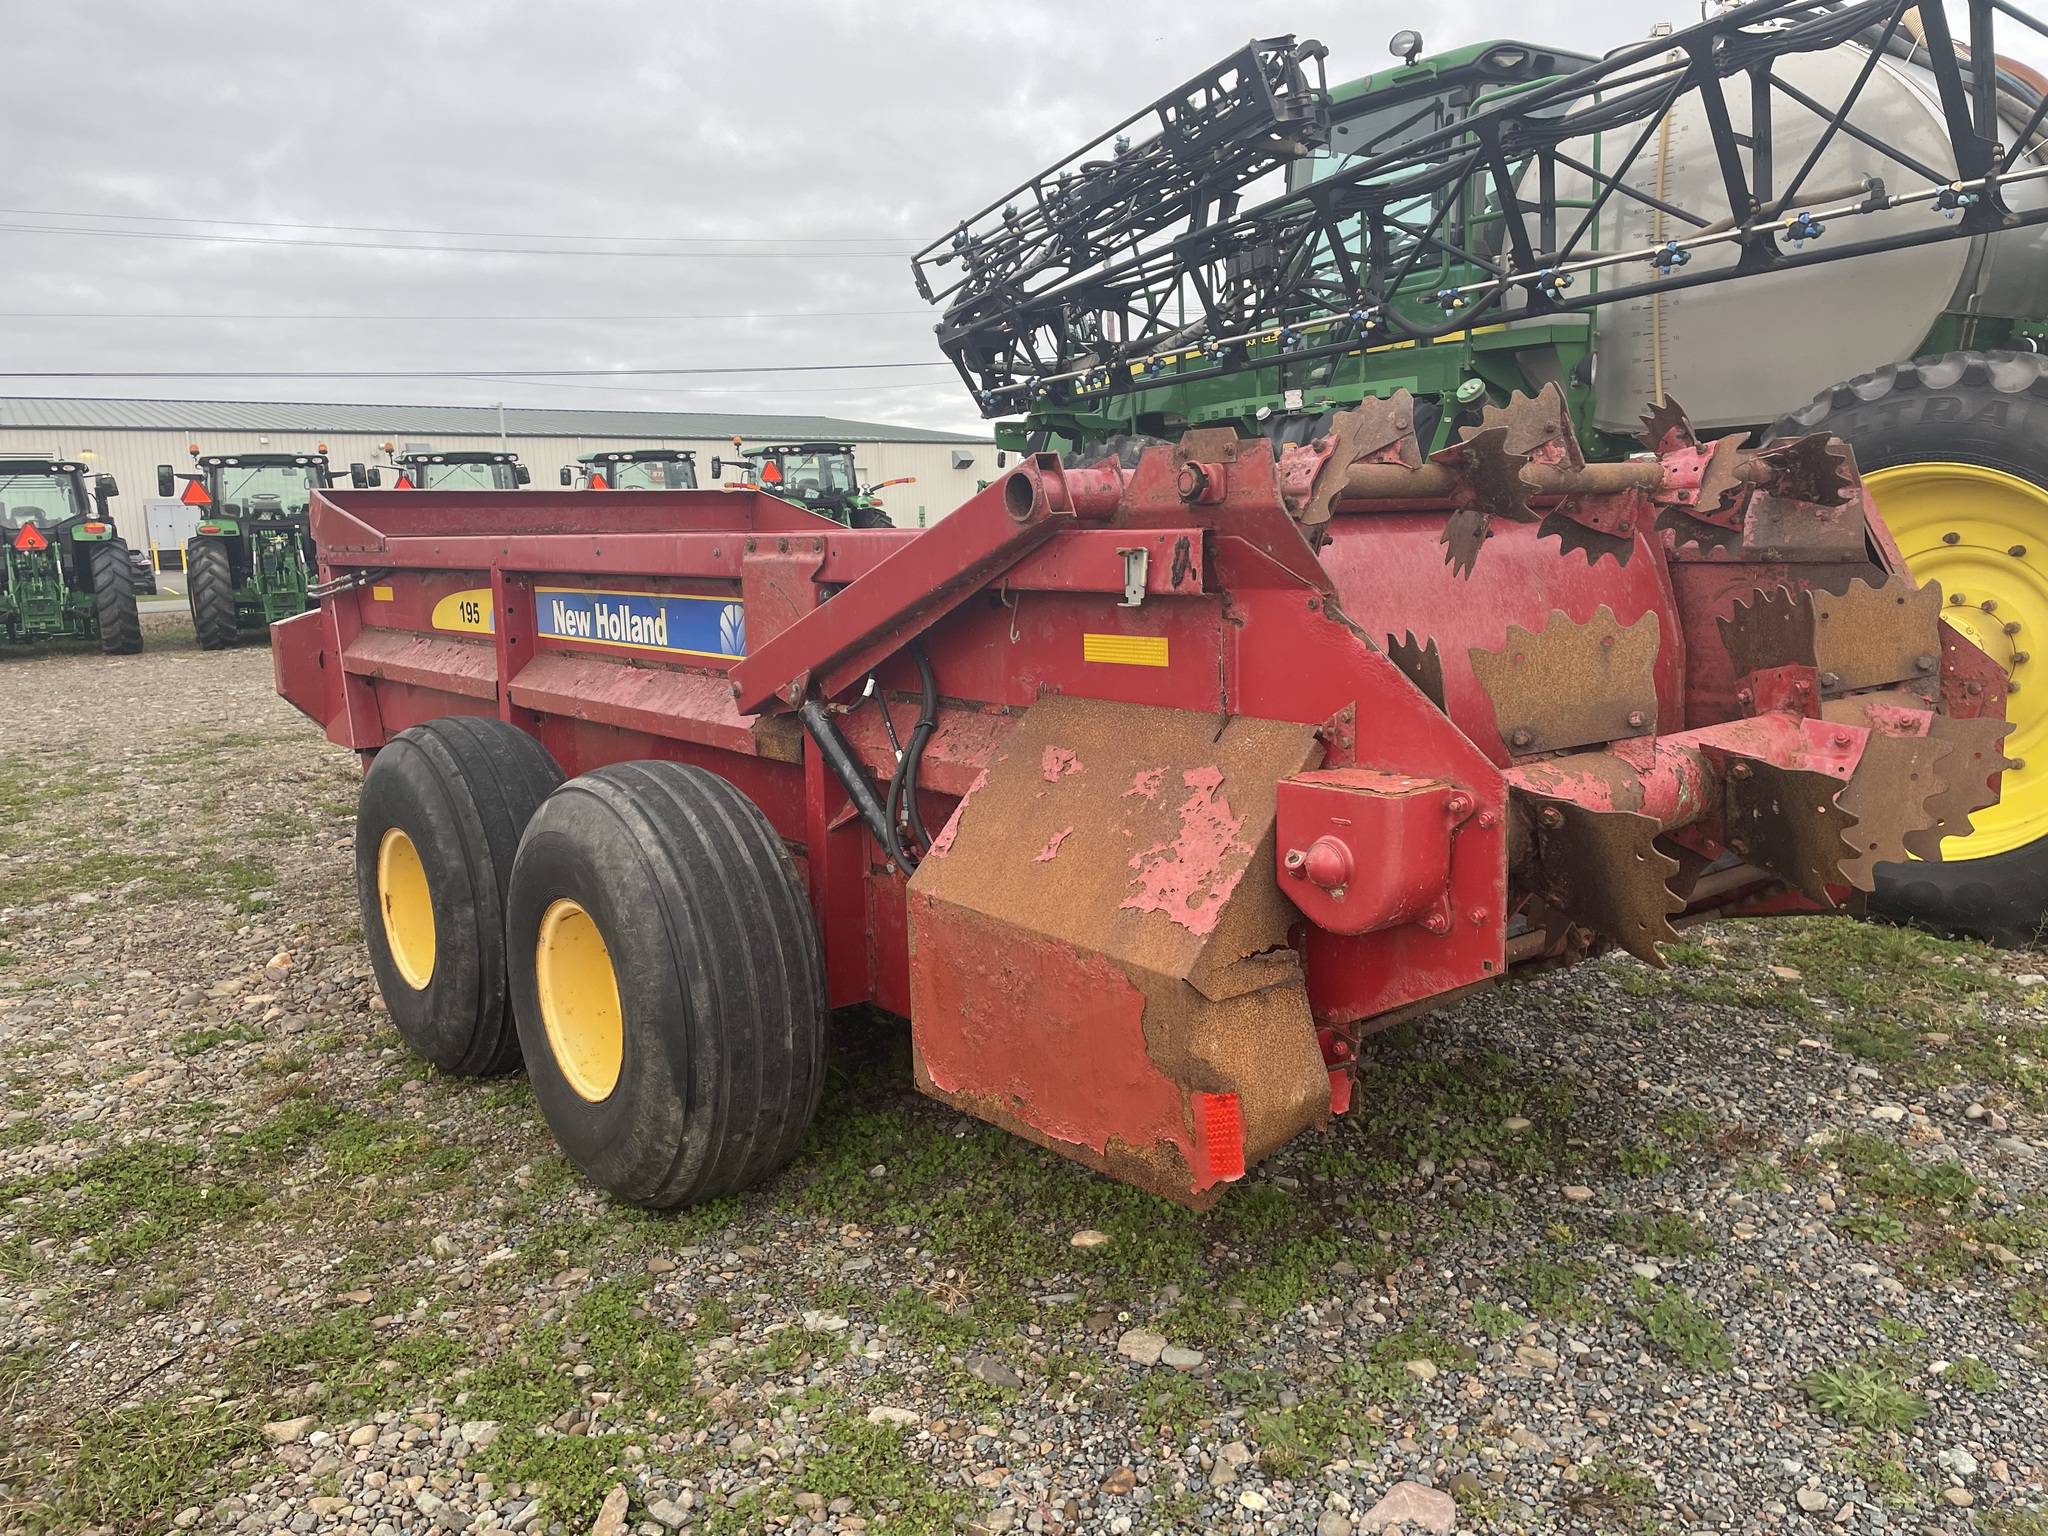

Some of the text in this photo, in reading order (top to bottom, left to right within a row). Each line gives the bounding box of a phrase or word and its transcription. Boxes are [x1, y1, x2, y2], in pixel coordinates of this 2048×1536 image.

[459, 601, 480, 624] 195
[552, 599, 668, 646] New Holland
